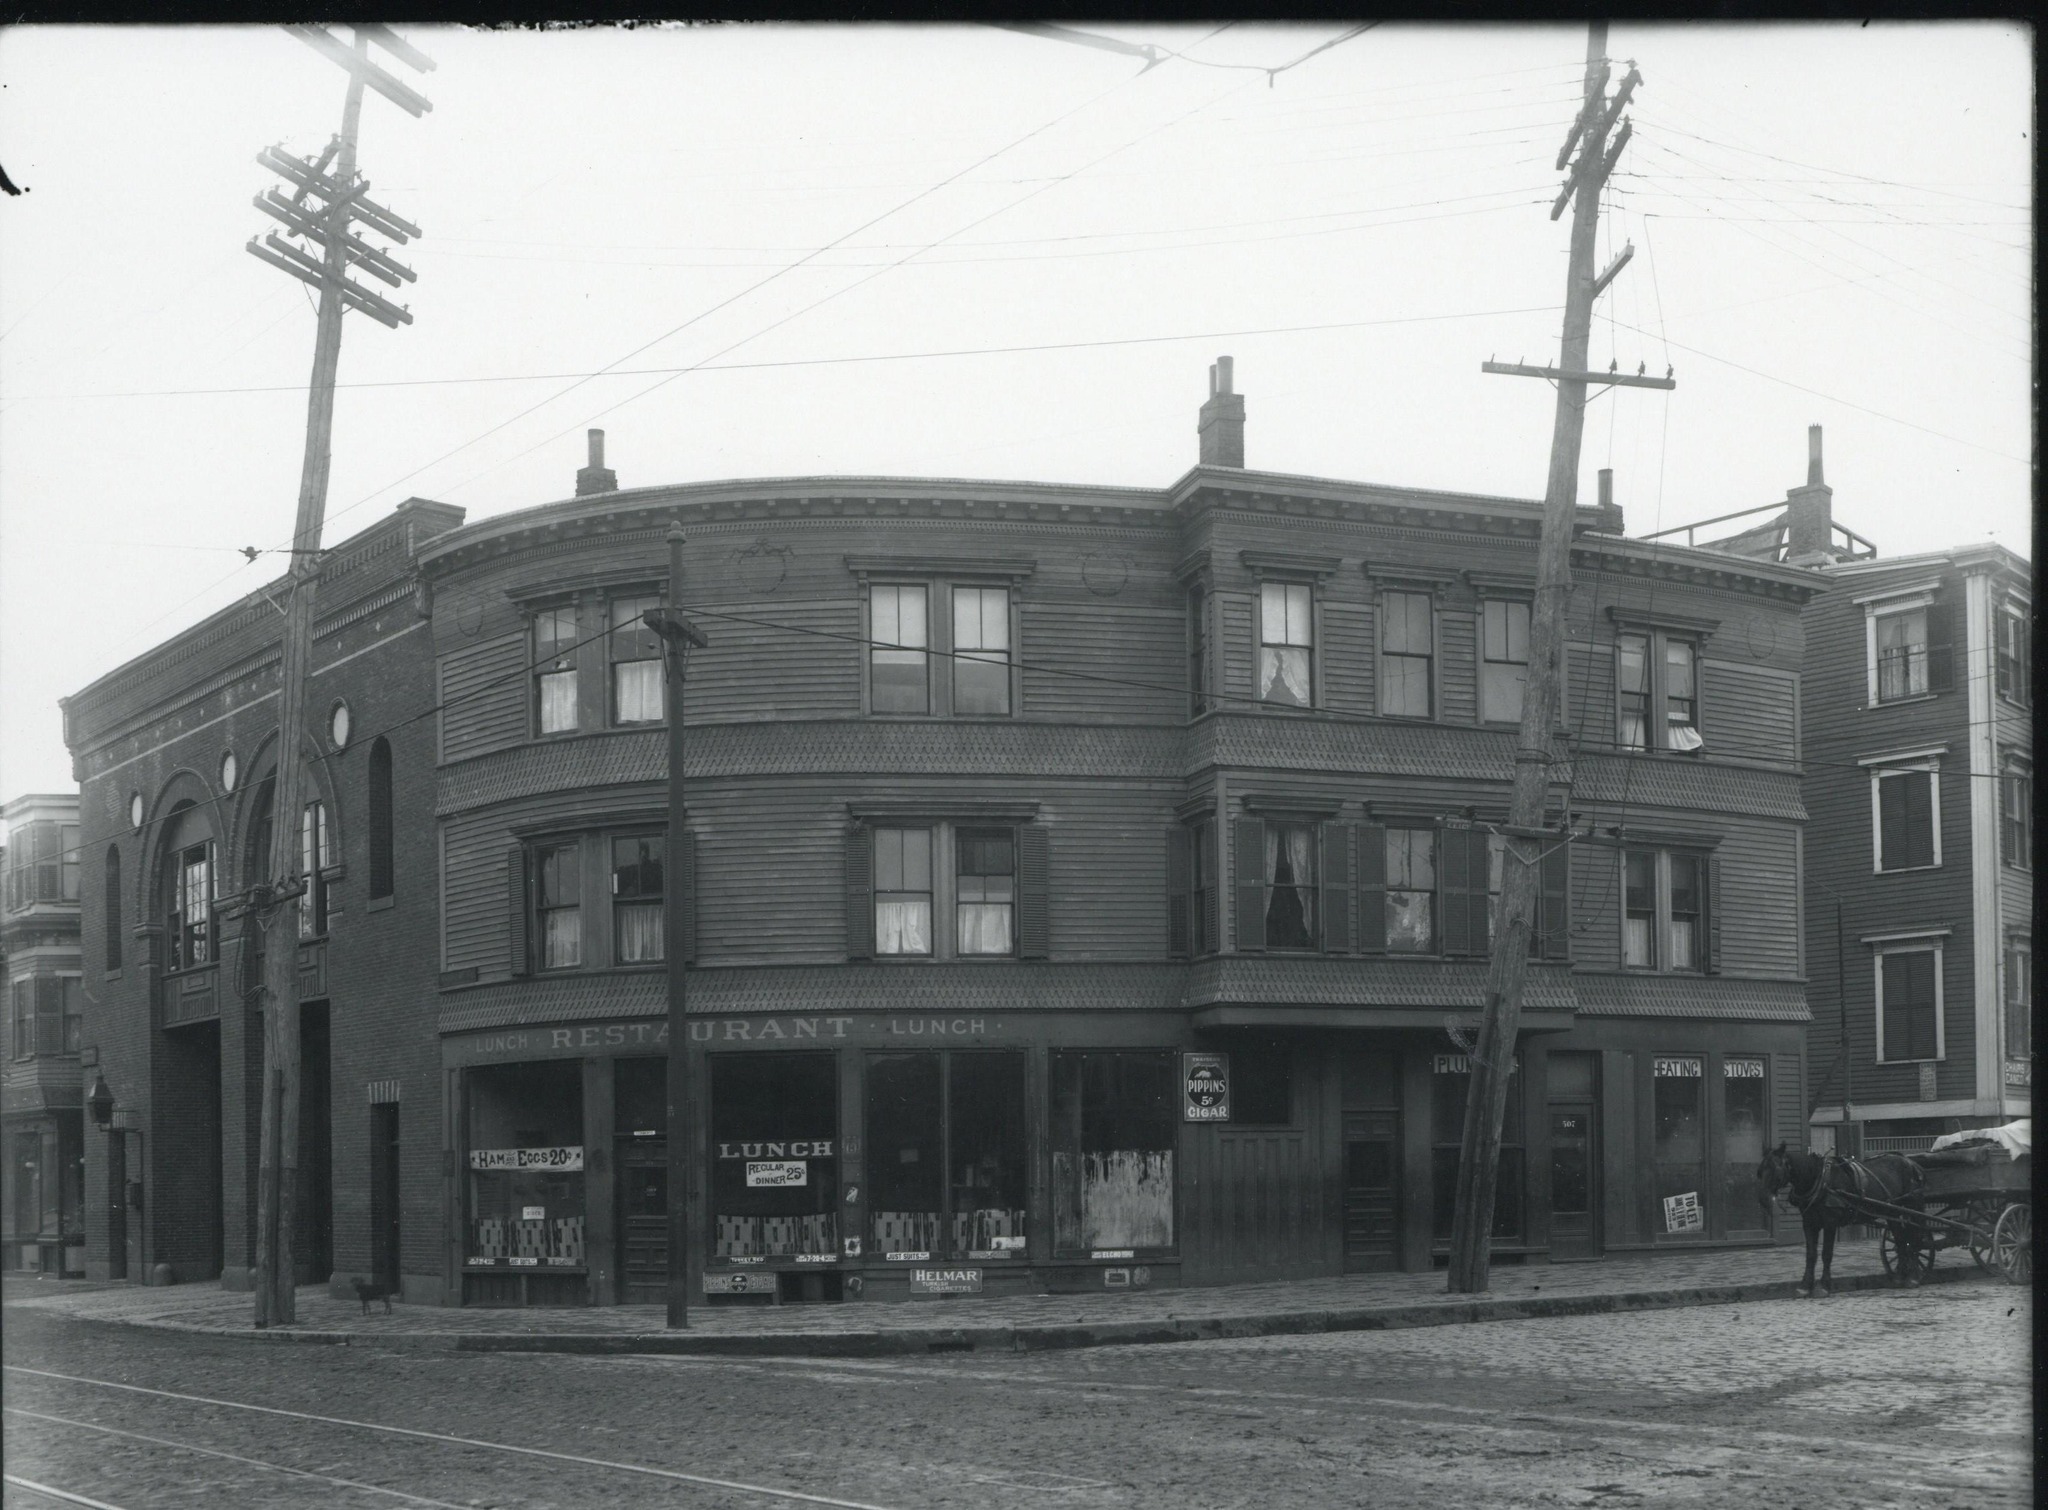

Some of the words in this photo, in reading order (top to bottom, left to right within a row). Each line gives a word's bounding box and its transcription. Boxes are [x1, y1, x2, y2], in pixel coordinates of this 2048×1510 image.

[476, 1034, 529, 1053] LUNCH
[892, 1019, 986, 1035] LUNCH
[1654, 1061, 1698, 1077] HEATING
[1724, 1062, 1761, 1077] STOVES
[1188, 1079, 1226, 1093] PIPPINS
[1187, 1105, 1228, 1118] CIGAR
[719, 1141, 833, 1159] LUNCH
[478, 1151, 505, 1168] HAM
[748, 1163, 785, 1176] REGULAR
[755, 1175, 787, 1185] DINNER
[887, 1253, 902, 1261] JUST
[915, 1269, 978, 1282] HELMAR
